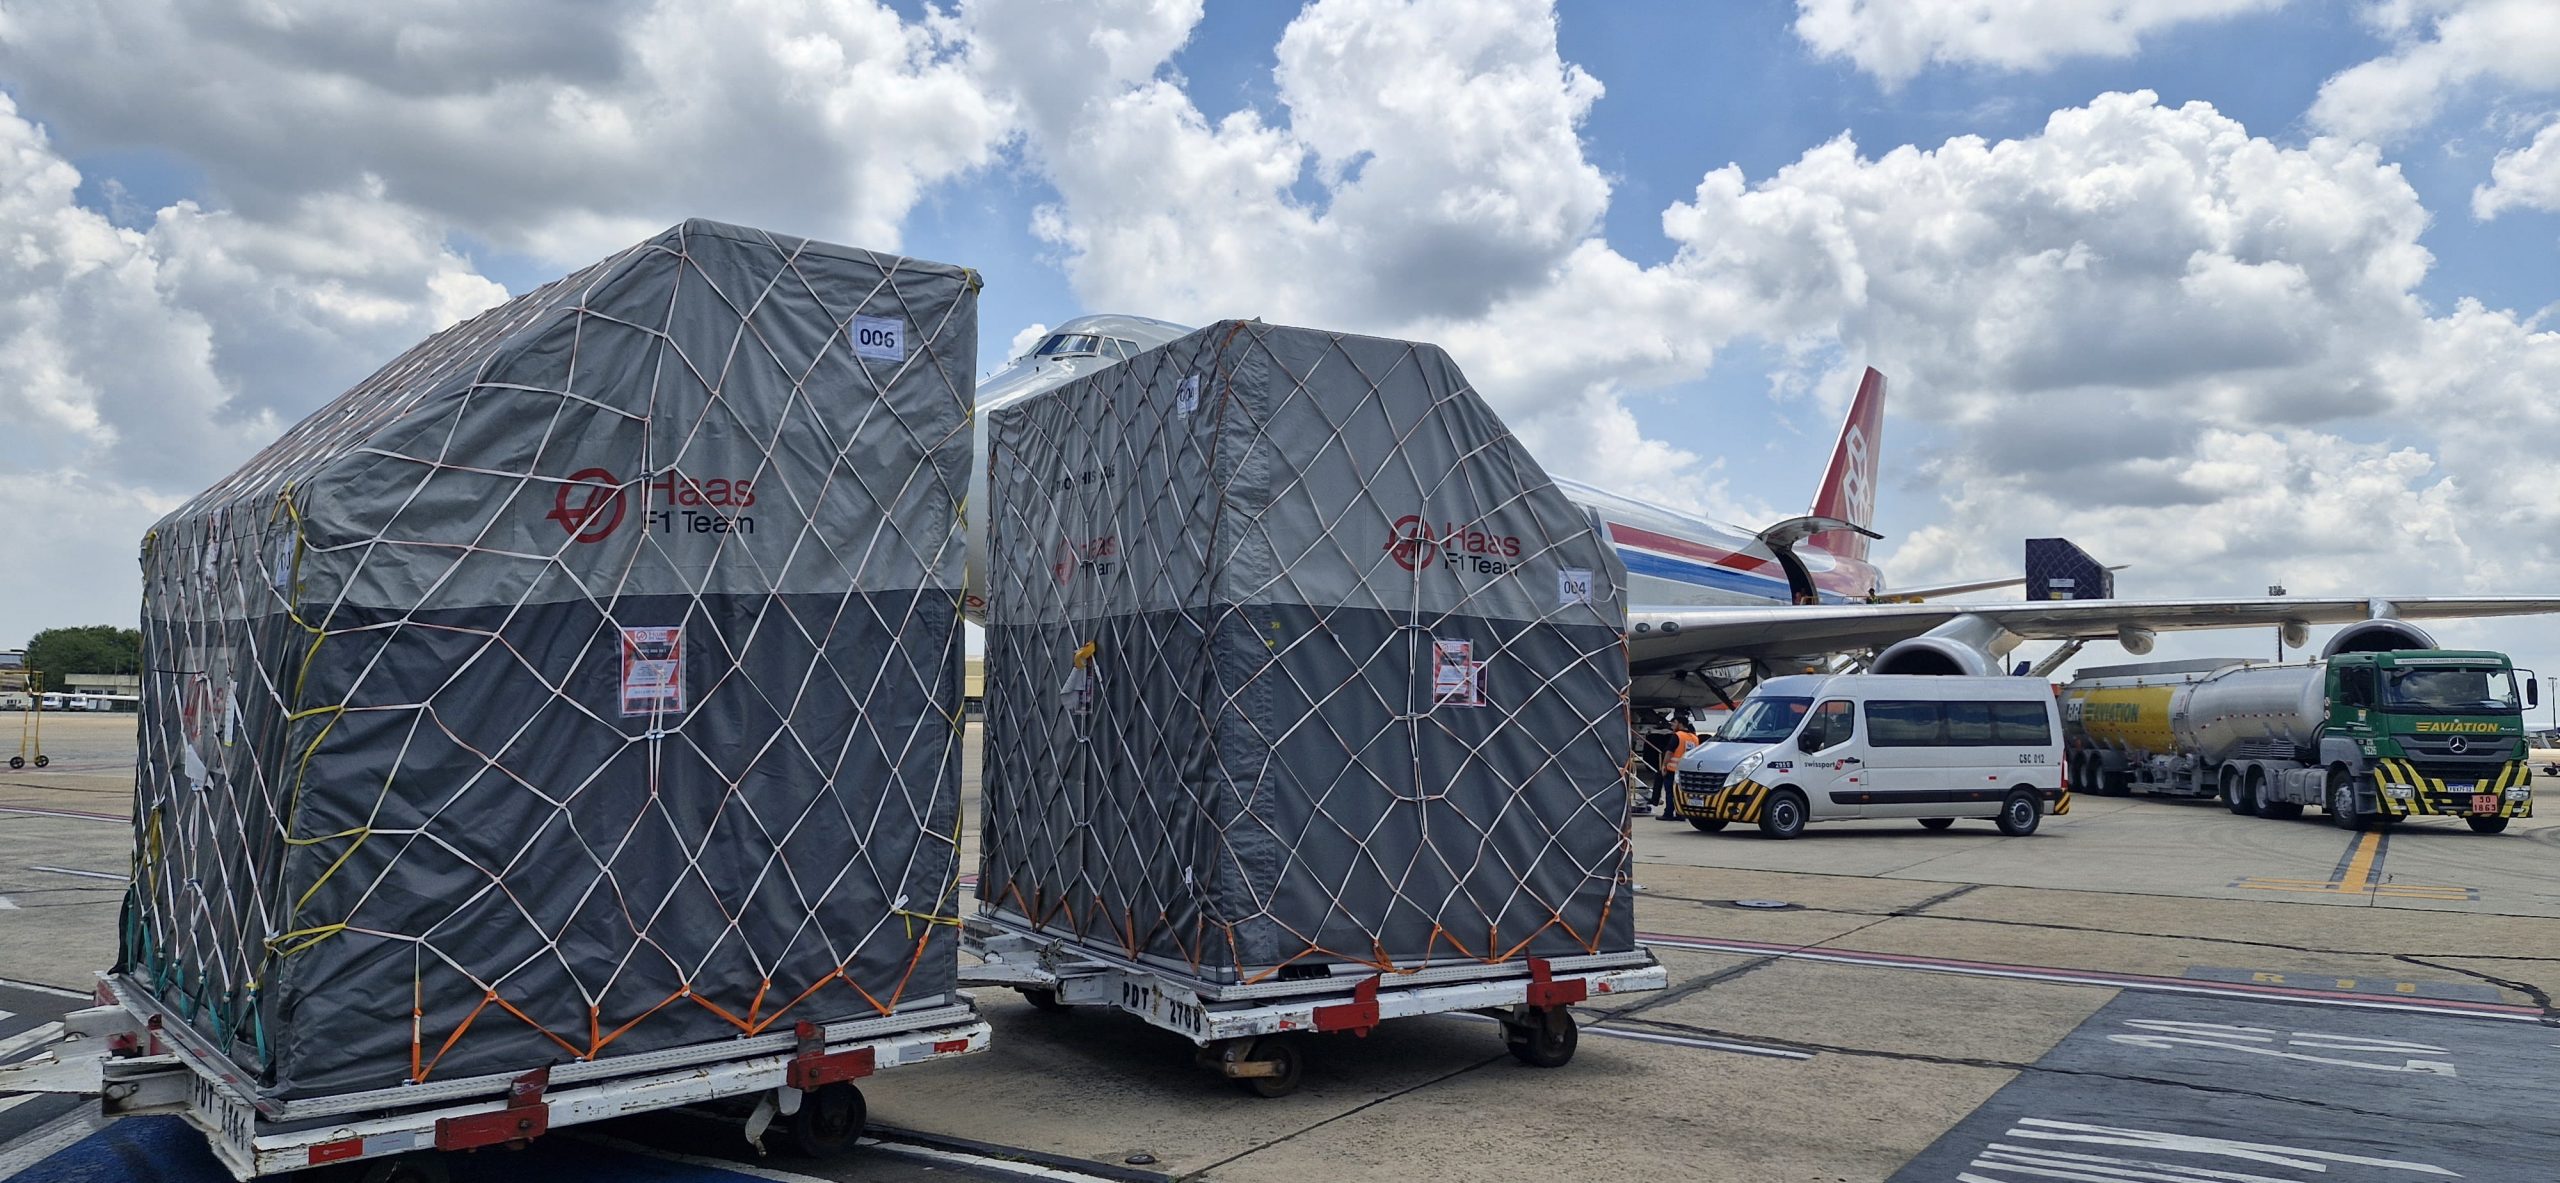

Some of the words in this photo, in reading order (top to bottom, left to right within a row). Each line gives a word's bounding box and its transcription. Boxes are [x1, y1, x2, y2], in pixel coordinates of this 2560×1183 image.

[860, 328, 895, 348] 006
[646, 470, 755, 508] Haas
[642, 510, 671, 534] F1
[681, 510, 754, 535] Team
[1445, 522, 1521, 558] Haas
[1444, 552, 1465, 571] F1
[1468, 555, 1518, 577] Team
[1563, 581, 1587, 595] 004
[2067, 703, 2082, 722] BR
[2093, 703, 2140, 723] AVIATION
[2430, 722, 2498, 733] AVIATION
[1804, 760, 1835, 770] swissport
[2019, 753, 2031, 764] CSC
[2034, 753, 2045, 764] 012
[1123, 981, 1149, 1010] PDT
[195, 1073, 214, 1114] PDT
